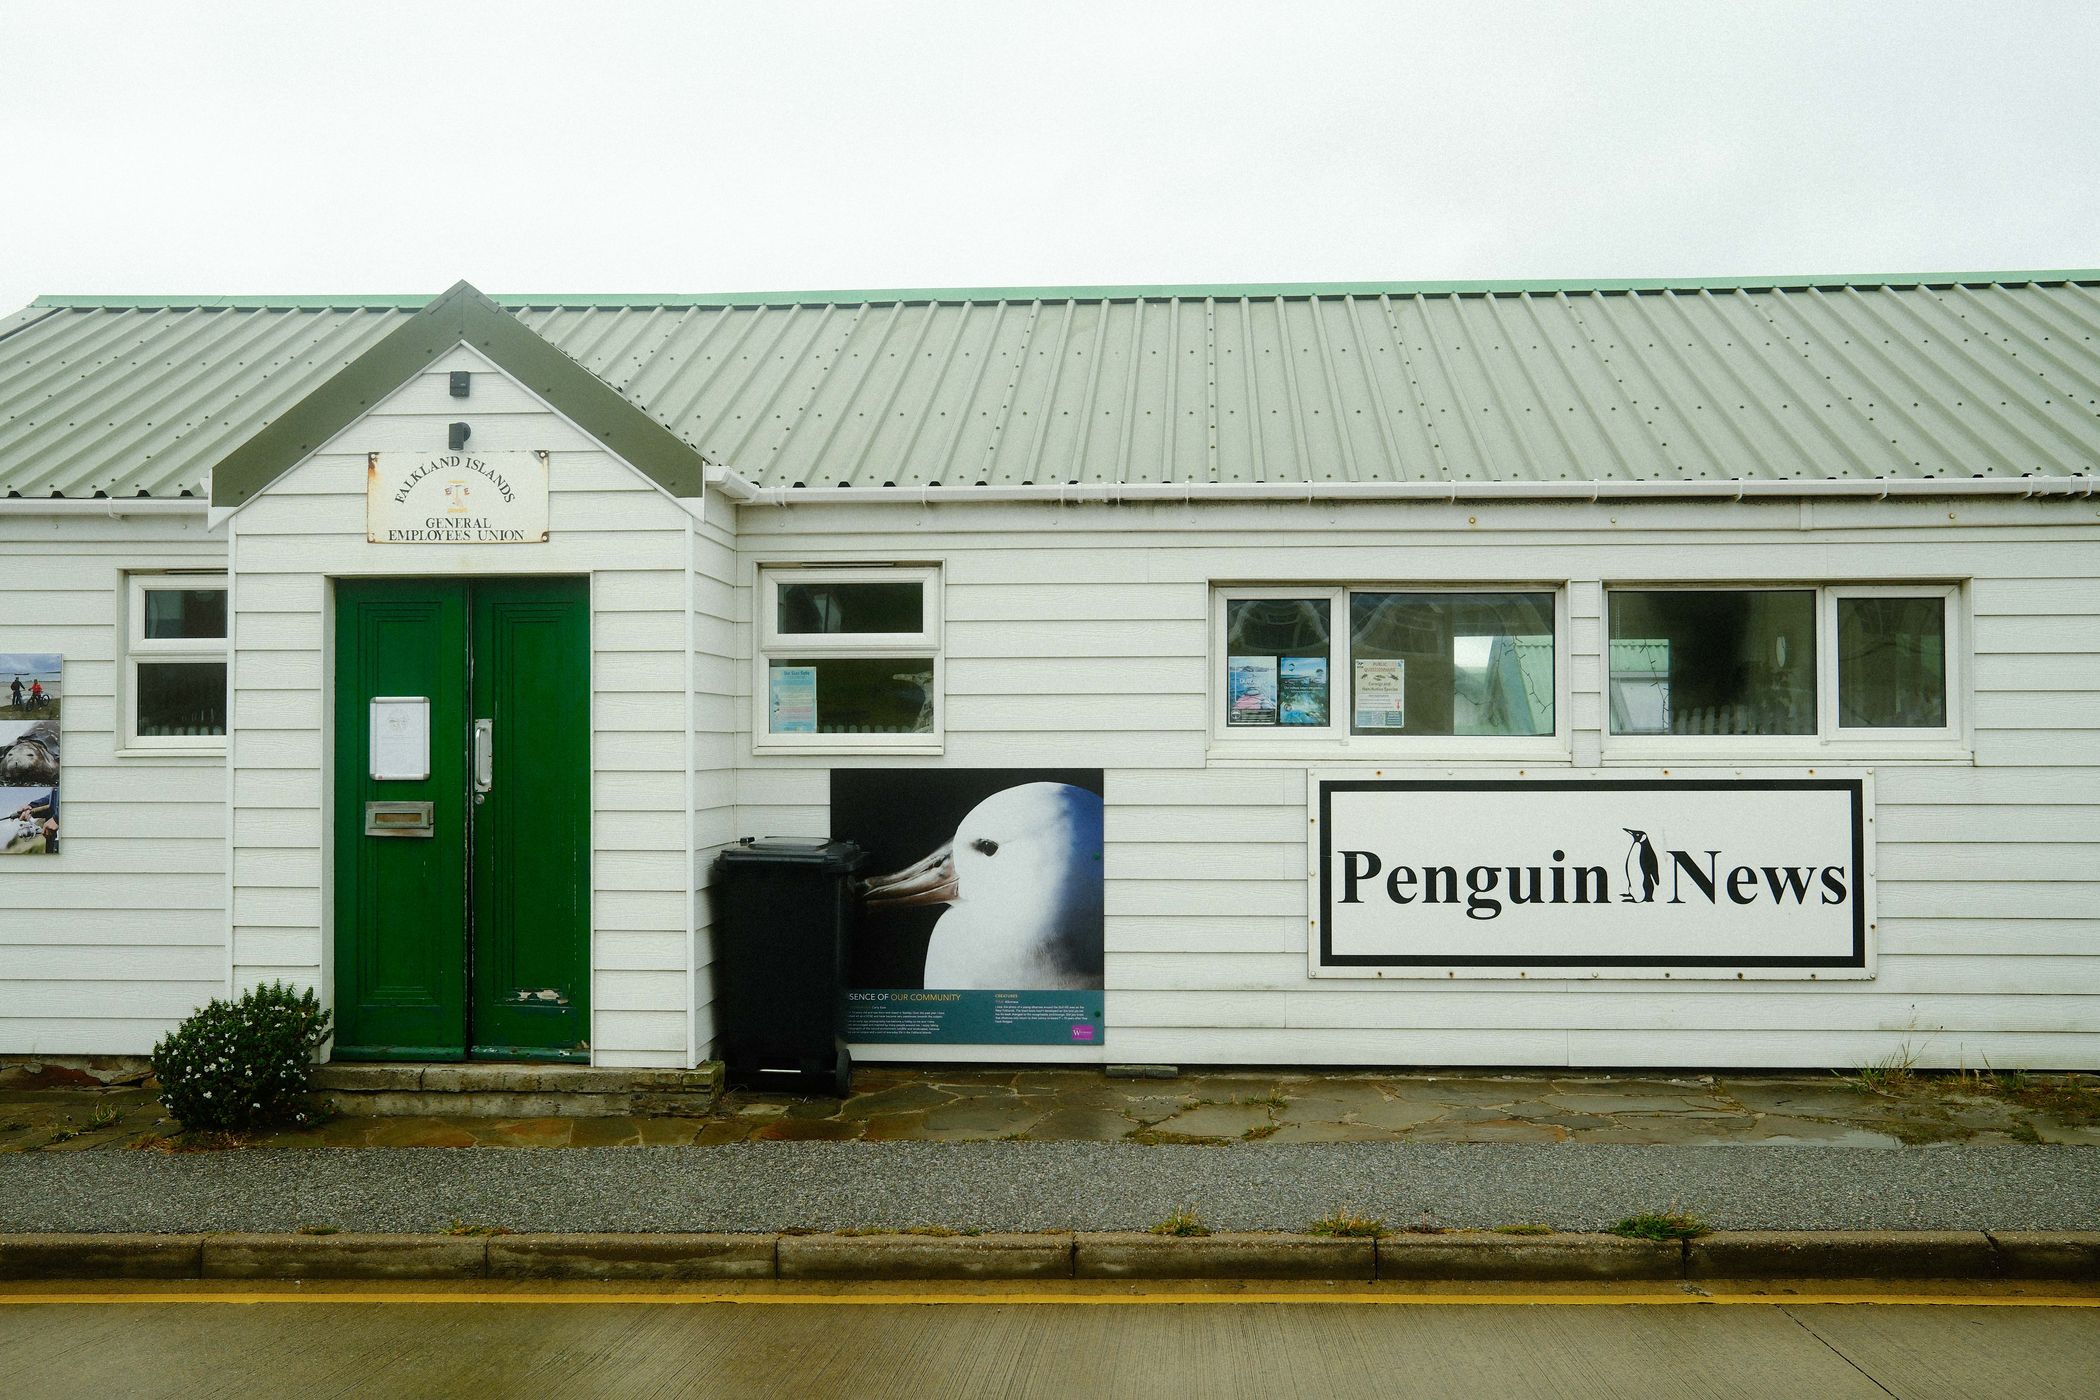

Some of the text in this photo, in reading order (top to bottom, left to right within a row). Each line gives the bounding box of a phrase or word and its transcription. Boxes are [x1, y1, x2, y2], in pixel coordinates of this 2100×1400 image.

[394, 455, 516, 504] FALKLAND ISLANDS
[425, 517, 492, 529] GENERAL
[388, 530, 524, 541] EMPLOYEES UNION
[1337, 848, 1848, 921] Penguin News
[849, 993, 961, 1002] SENCE OF OUR COMMUNITY
